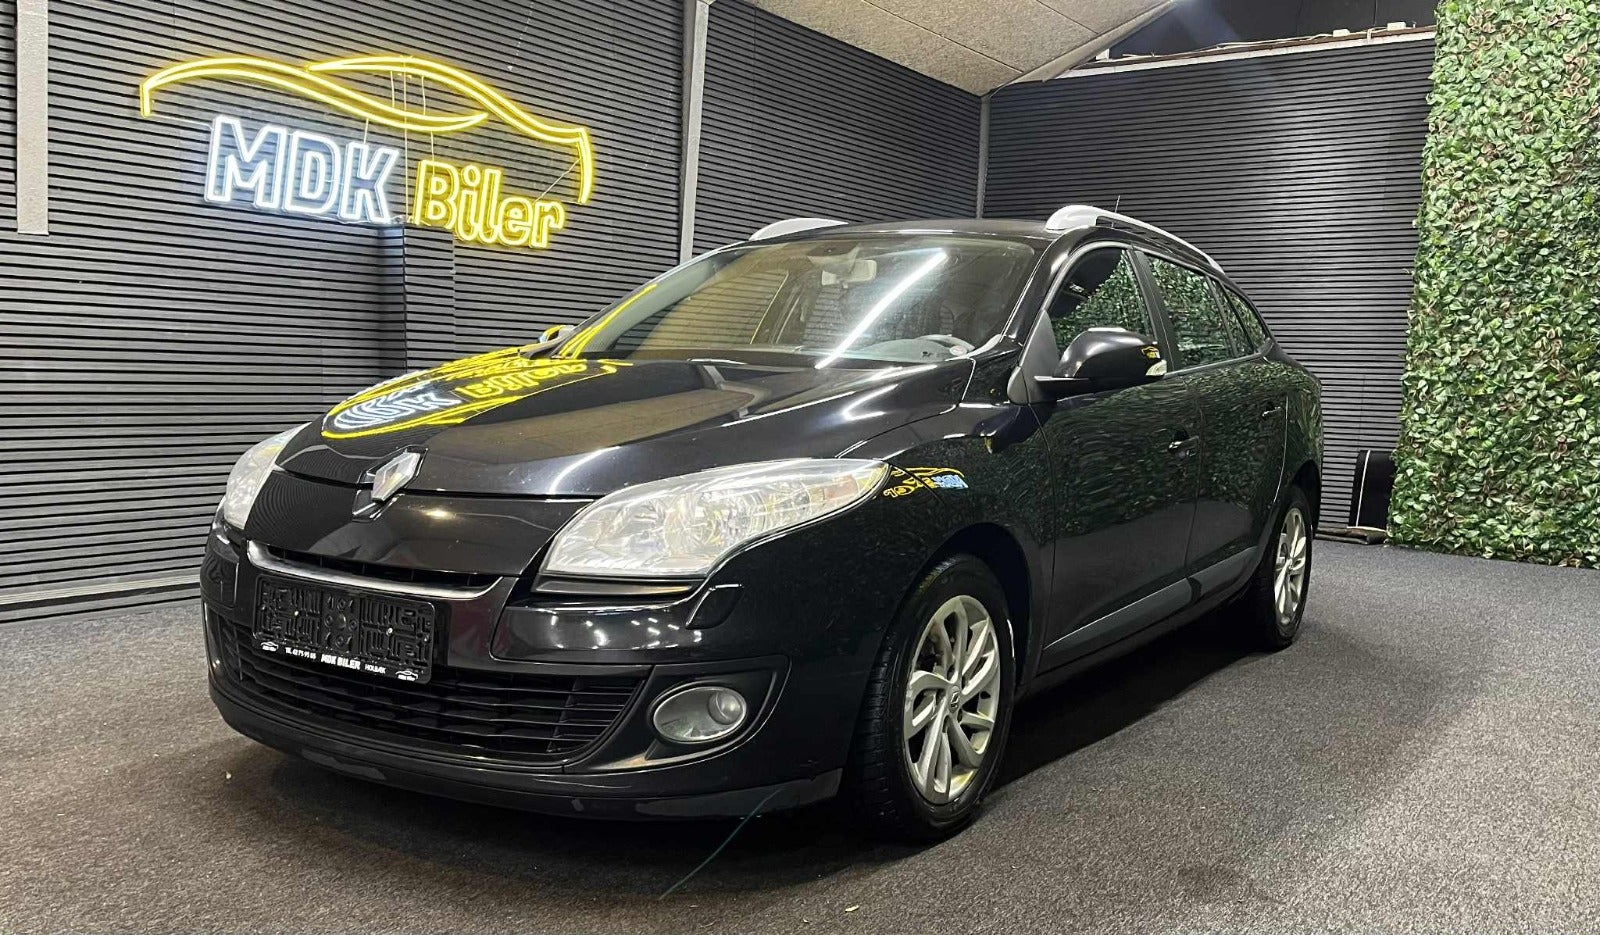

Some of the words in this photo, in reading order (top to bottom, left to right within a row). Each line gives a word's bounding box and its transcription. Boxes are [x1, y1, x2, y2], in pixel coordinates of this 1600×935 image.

[204, 115, 399, 225] MDK
[411, 159, 565, 249] Biler
[320, 653, 337, 665] MDK
[337, 656, 361, 670] BILER
